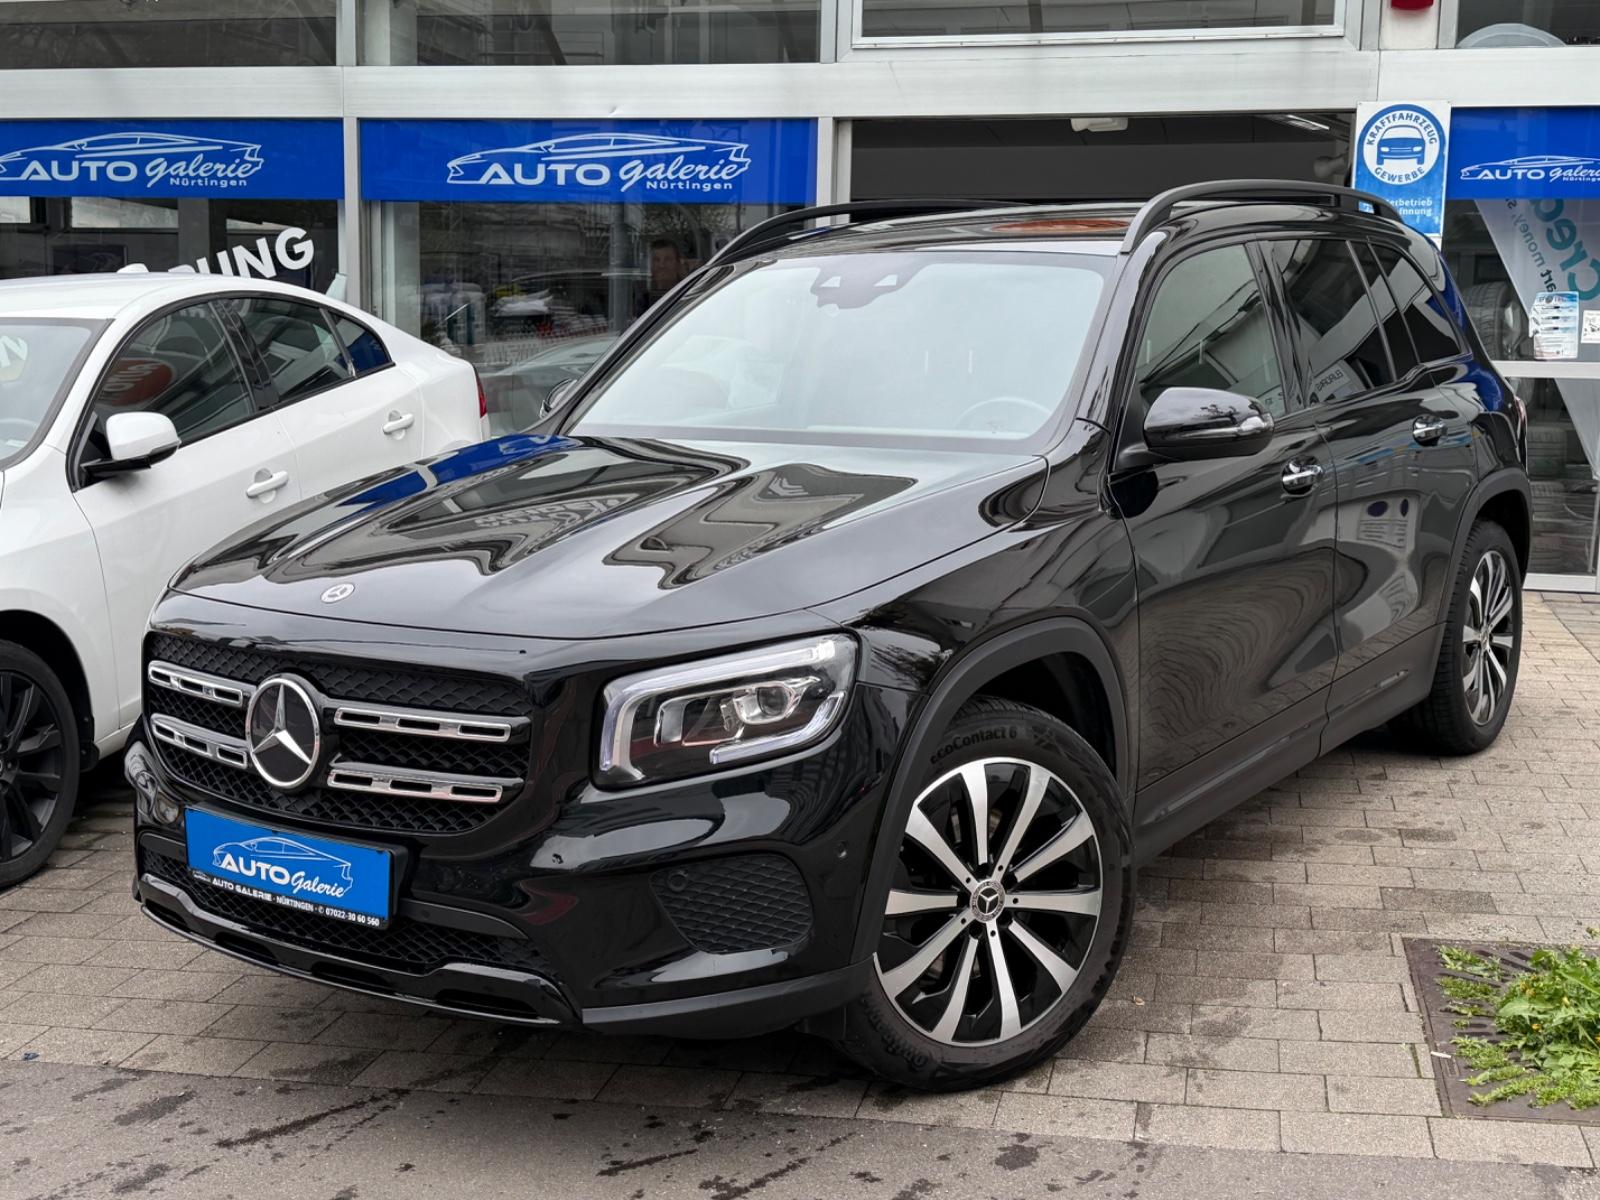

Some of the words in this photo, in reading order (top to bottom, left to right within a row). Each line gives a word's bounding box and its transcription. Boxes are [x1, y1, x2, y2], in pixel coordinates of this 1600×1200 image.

[1367, 113, 1437, 145] KRAFTFAHRZEUG
[23, 161, 138, 181] AUTO
[145, 154, 254, 187] galerie
[481, 162, 610, 185] AUTO
[619, 155, 739, 192] galerie
[1374, 167, 1425, 182] GEWERBE
[1478, 169, 1545, 179] AUTO
[169, 177, 247, 188] Nürtingen
[646, 181, 732, 192] Nürtingen
[1387, 197, 1433, 206] erbetrieb
[930, 727, 1006, 764] ecoContact
[220, 853, 290, 885] AUTO
[291, 871, 344, 897] Galerie
[212, 878, 234, 890] AUTO
[235, 884, 272, 901] GALERIE
